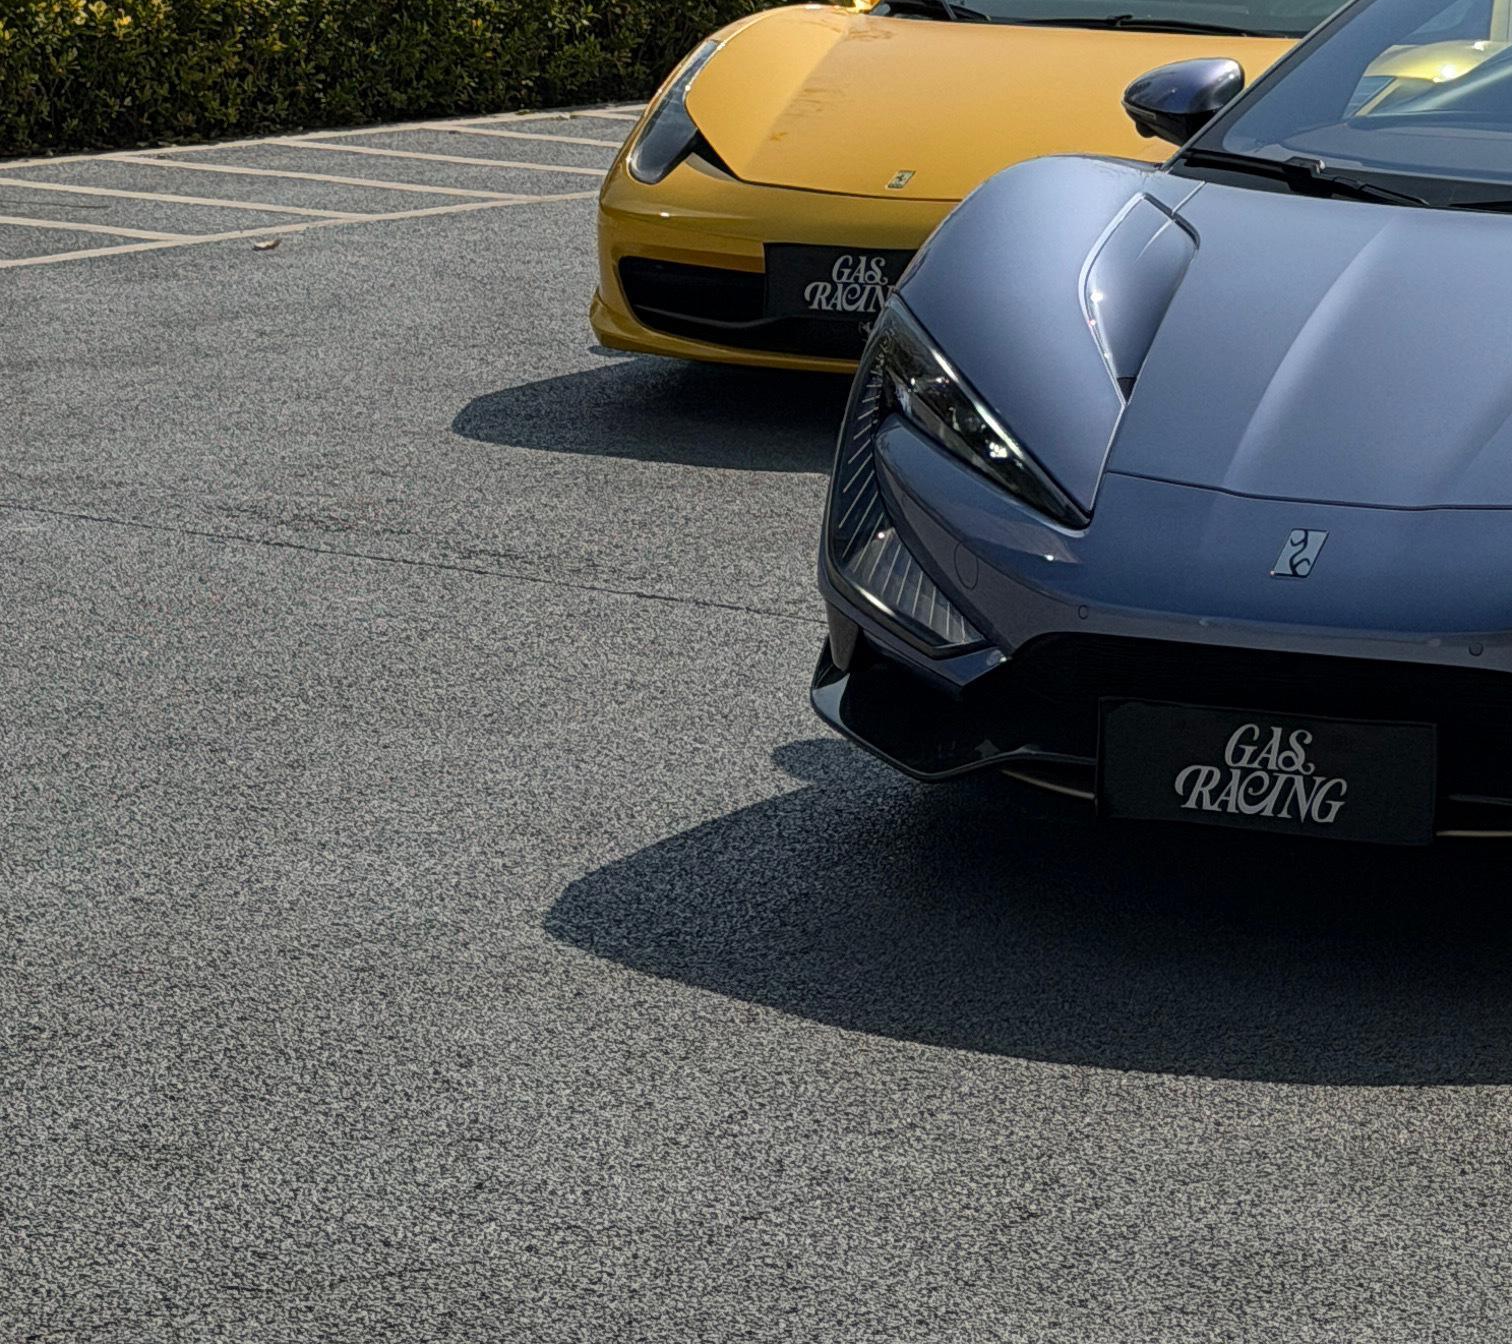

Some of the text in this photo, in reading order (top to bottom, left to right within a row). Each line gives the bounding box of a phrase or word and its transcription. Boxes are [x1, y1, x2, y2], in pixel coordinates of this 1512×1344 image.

[832, 254, 888, 286] GAS
[804, 281, 898, 312] RACIN
[1224, 723, 1316, 776] GAS
[1174, 765, 1348, 824] RACING
